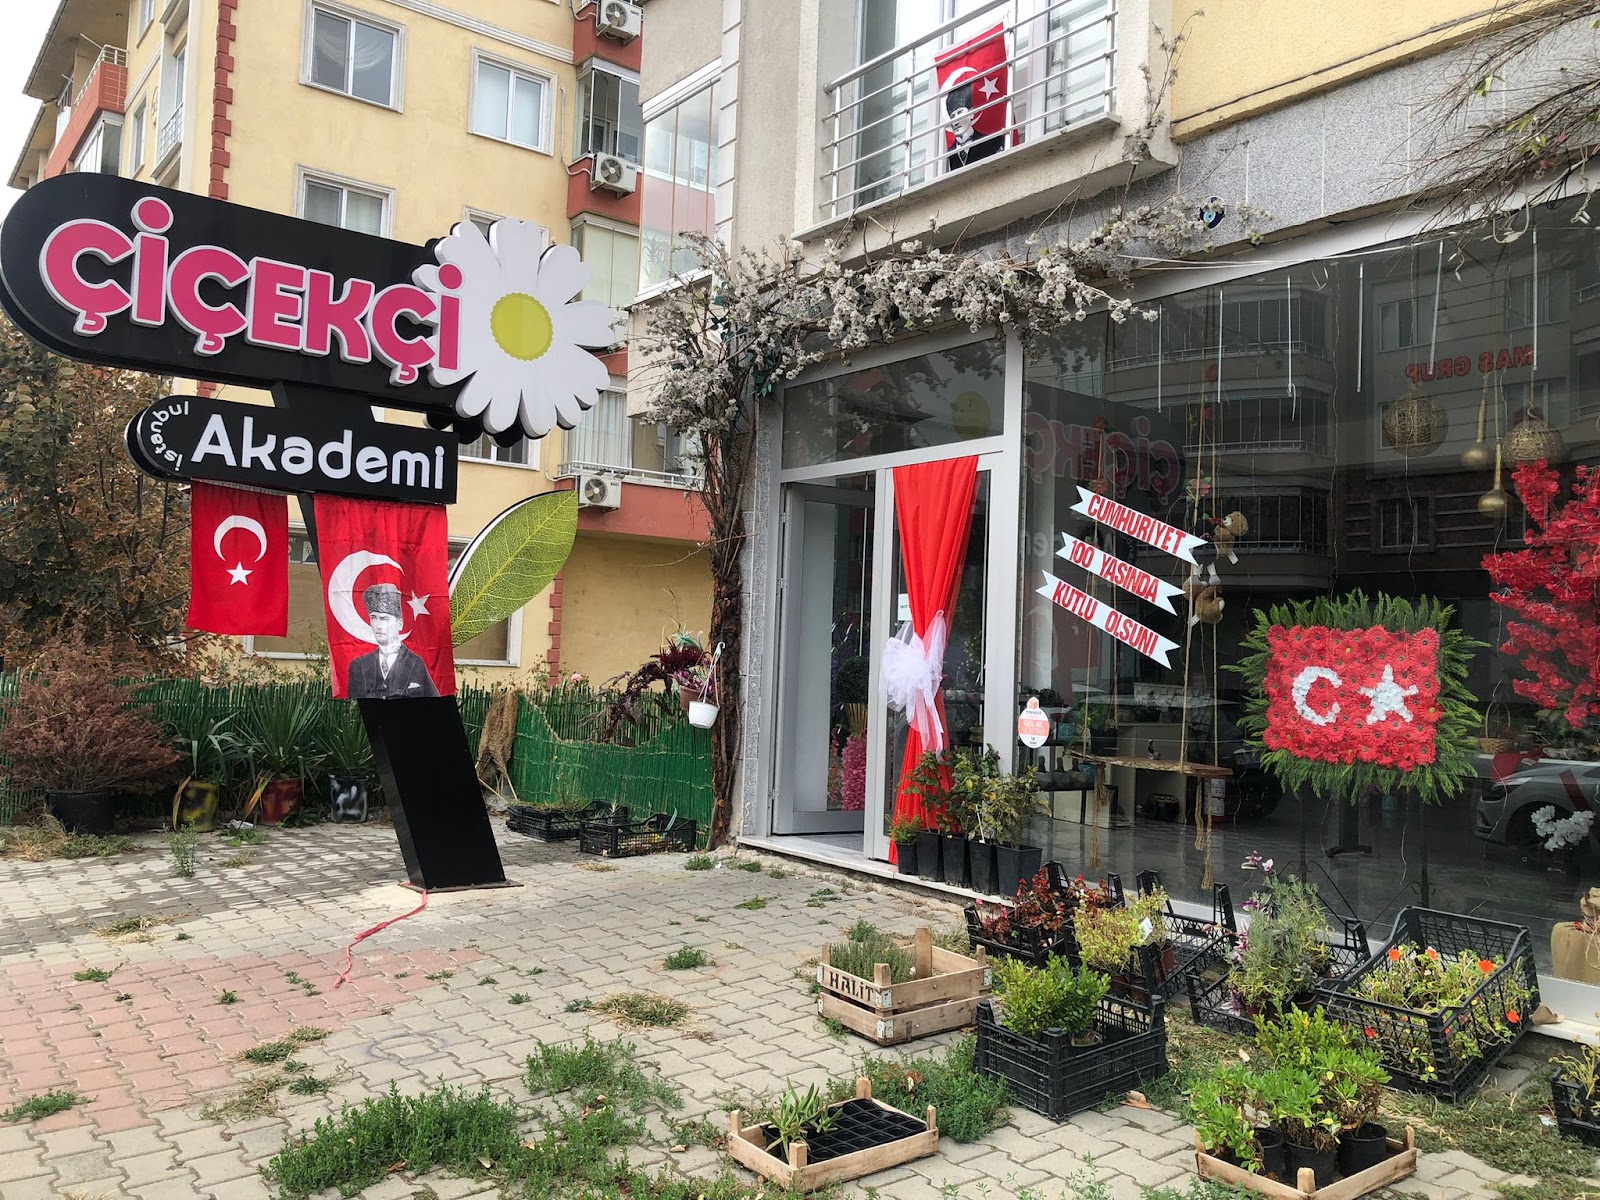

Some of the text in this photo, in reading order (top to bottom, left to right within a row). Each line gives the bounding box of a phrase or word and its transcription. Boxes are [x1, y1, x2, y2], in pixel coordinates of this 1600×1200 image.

[190, 413, 445, 490] Akademi
[1087, 494, 1186, 555] CUMHURİYET
[1069, 540, 1095, 569] 100
[1052, 580, 1098, 621] KUTLU
